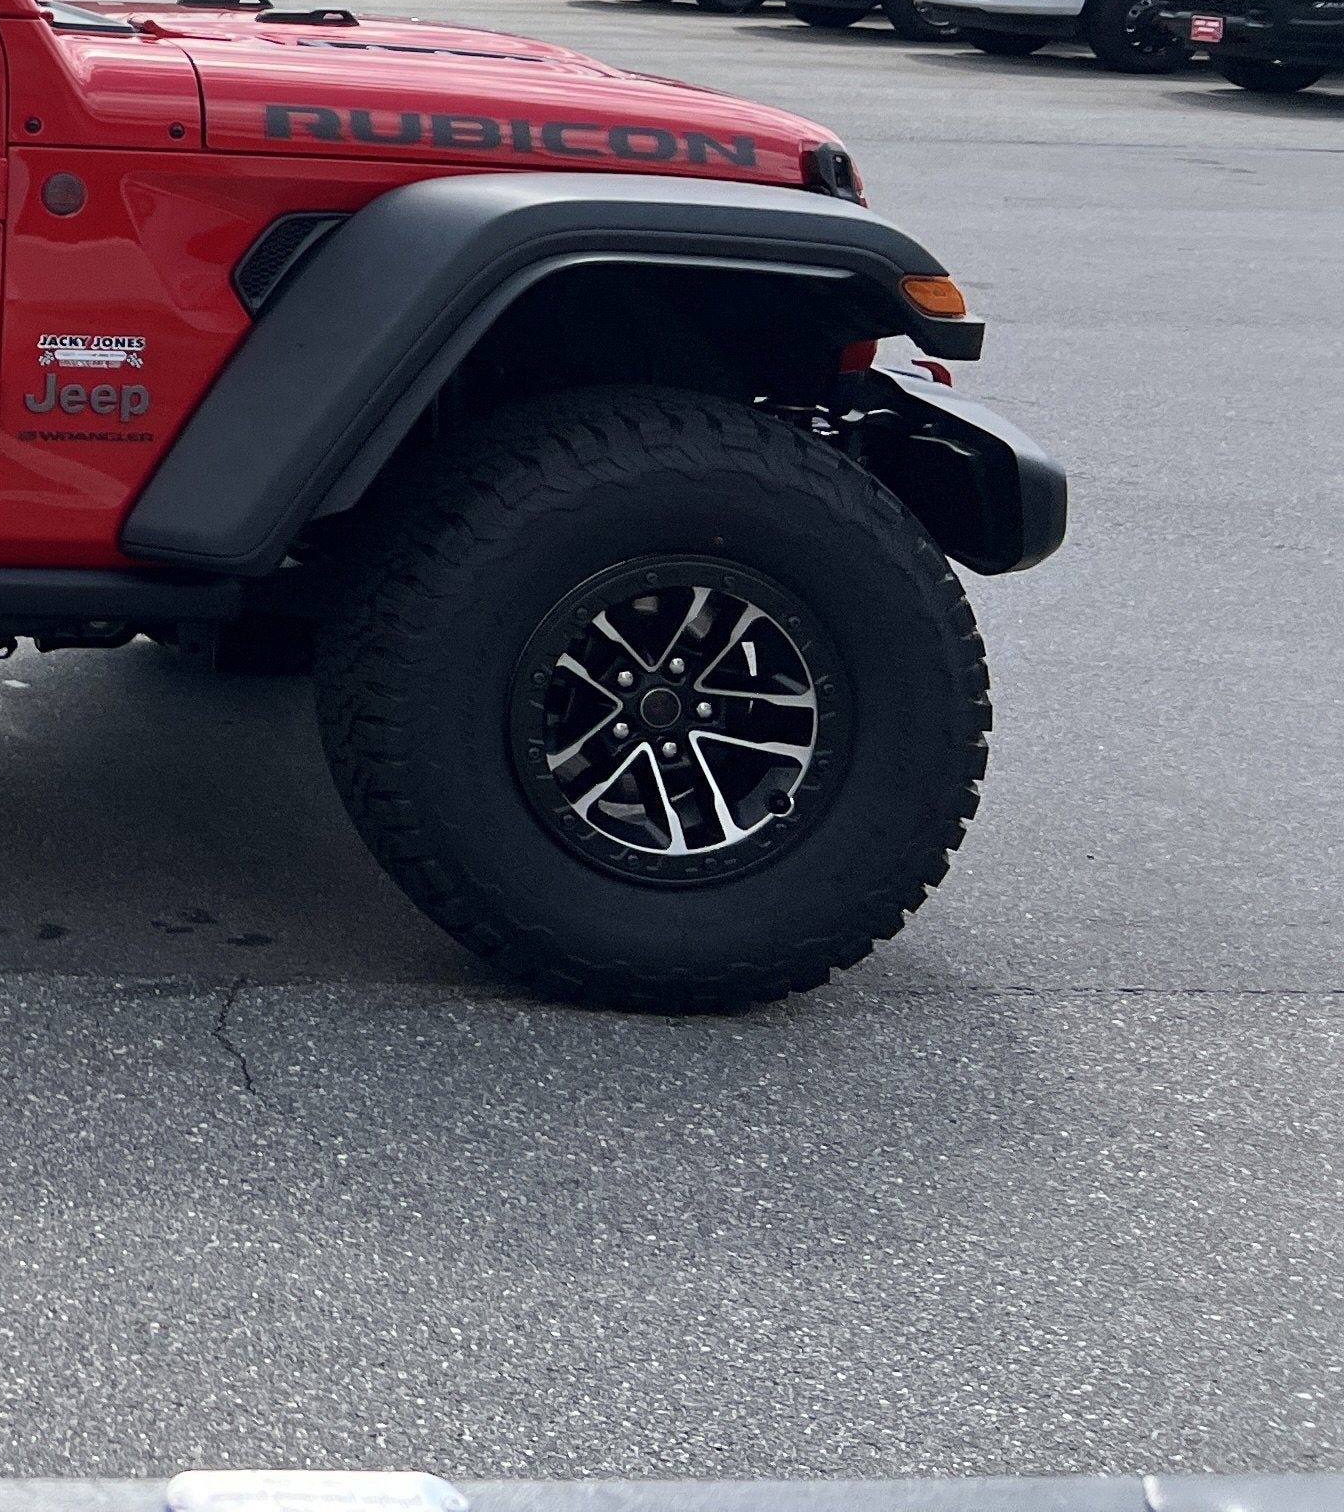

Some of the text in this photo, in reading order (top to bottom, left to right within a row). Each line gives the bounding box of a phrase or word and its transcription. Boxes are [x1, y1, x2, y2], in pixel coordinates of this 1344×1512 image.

[264, 103, 757, 167] RUBICON
[38, 335, 145, 349] JACKY JONES
[24, 372, 150, 423] Jeep
[40, 431, 154, 442] WRANGLER
